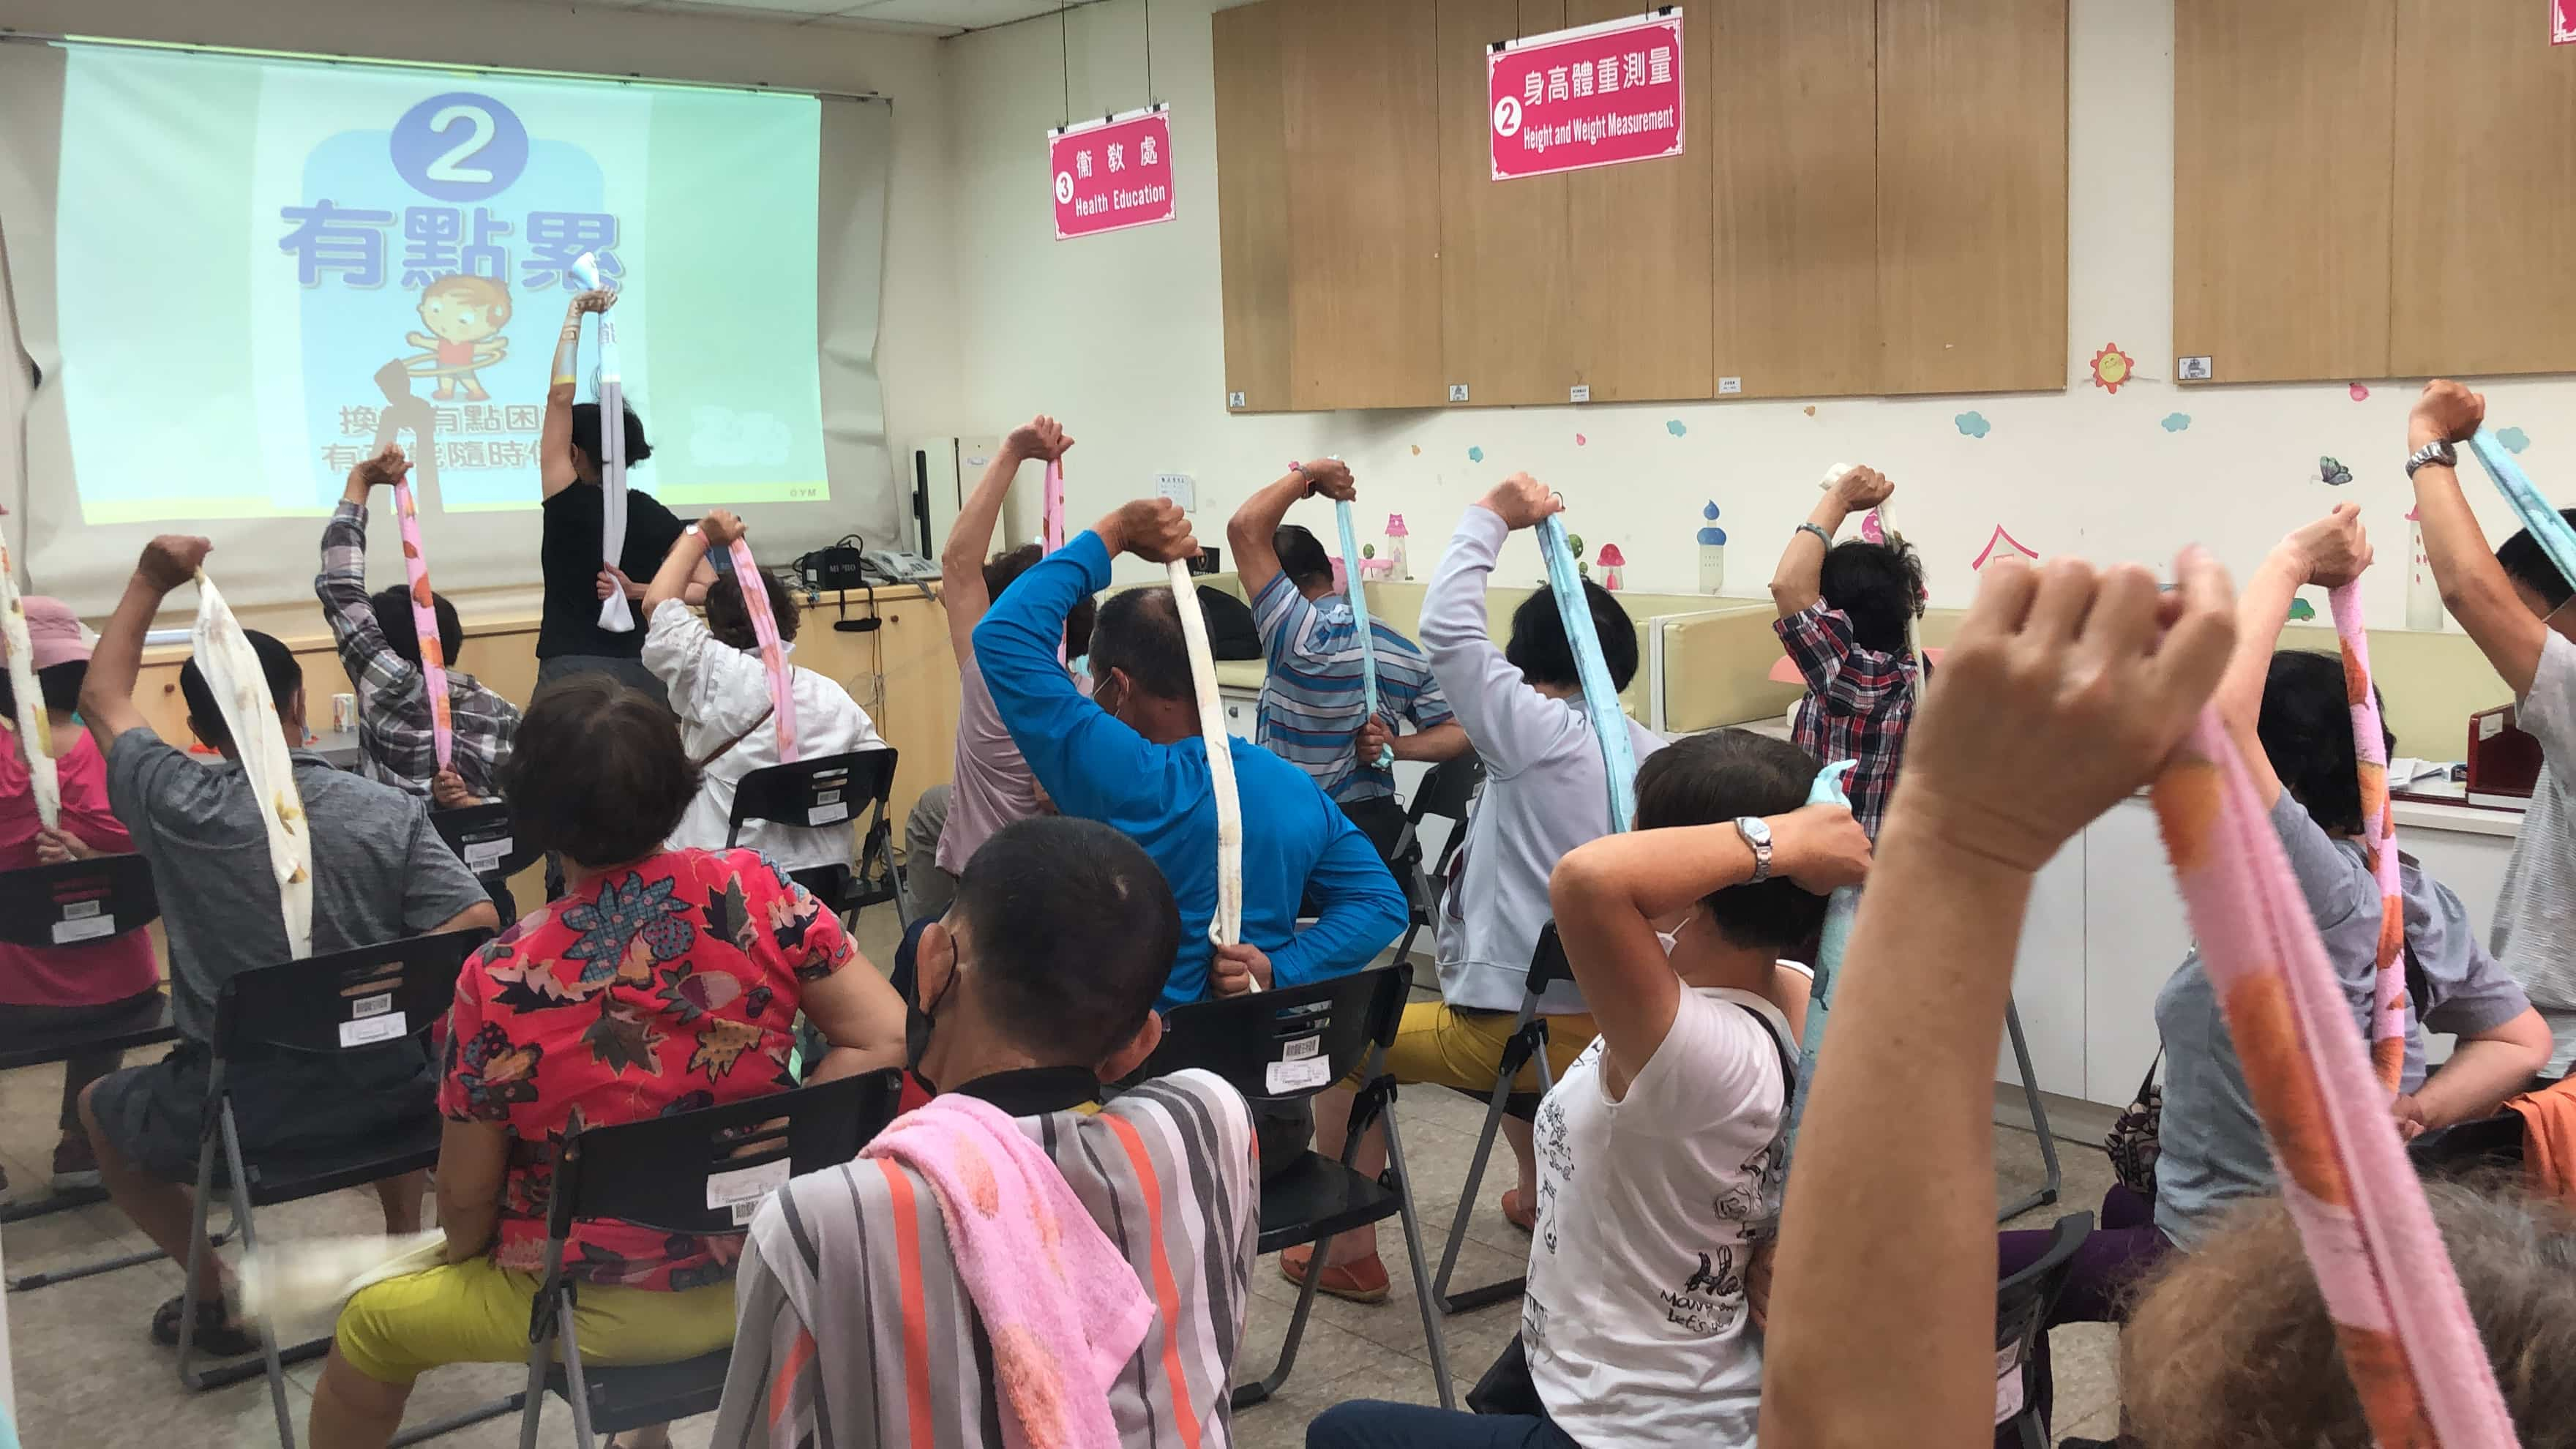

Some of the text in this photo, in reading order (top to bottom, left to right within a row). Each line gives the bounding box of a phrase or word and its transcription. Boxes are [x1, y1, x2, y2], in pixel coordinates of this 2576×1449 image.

[1524, 46, 1672, 105] 身高體重測量
[1501, 102, 1515, 130] 2
[1524, 105, 1674, 153] Height and Weight Measurement
[426, 105, 495, 183] 2
[1075, 183, 1166, 217] Health Education
[278, 198, 626, 293] 有點累
